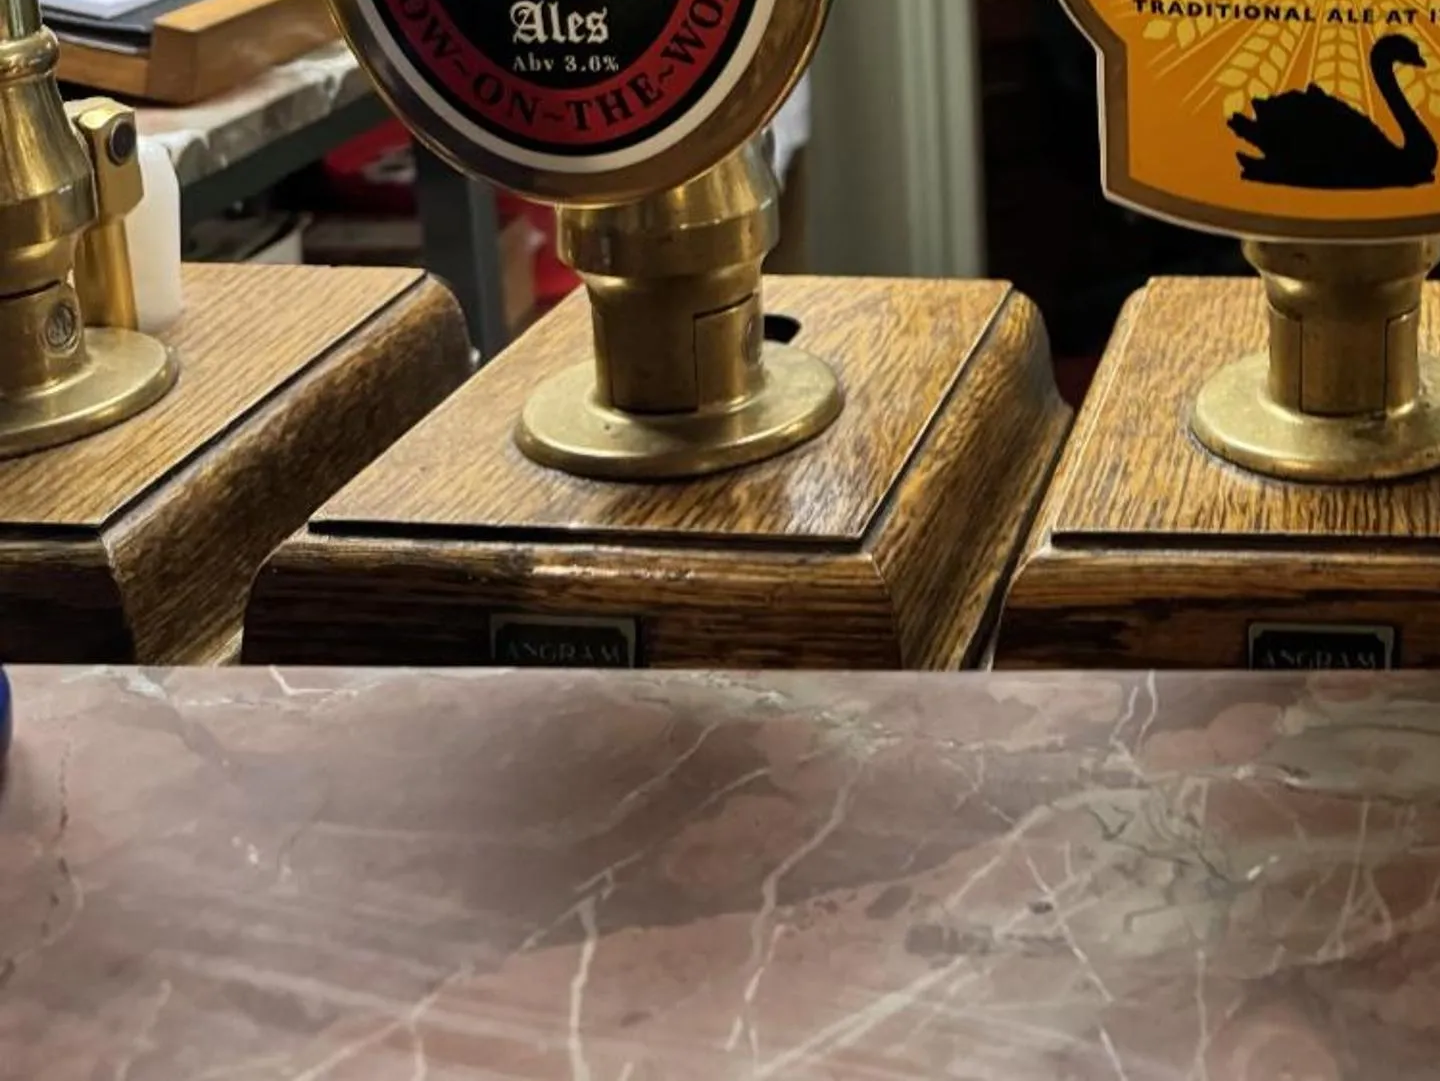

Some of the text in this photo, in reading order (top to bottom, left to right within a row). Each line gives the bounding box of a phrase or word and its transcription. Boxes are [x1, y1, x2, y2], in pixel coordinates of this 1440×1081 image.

[509, 0, 609, 44] Ales
[1326, 6, 1373, 25] ALE
[1385, 6, 1418, 25] AT
